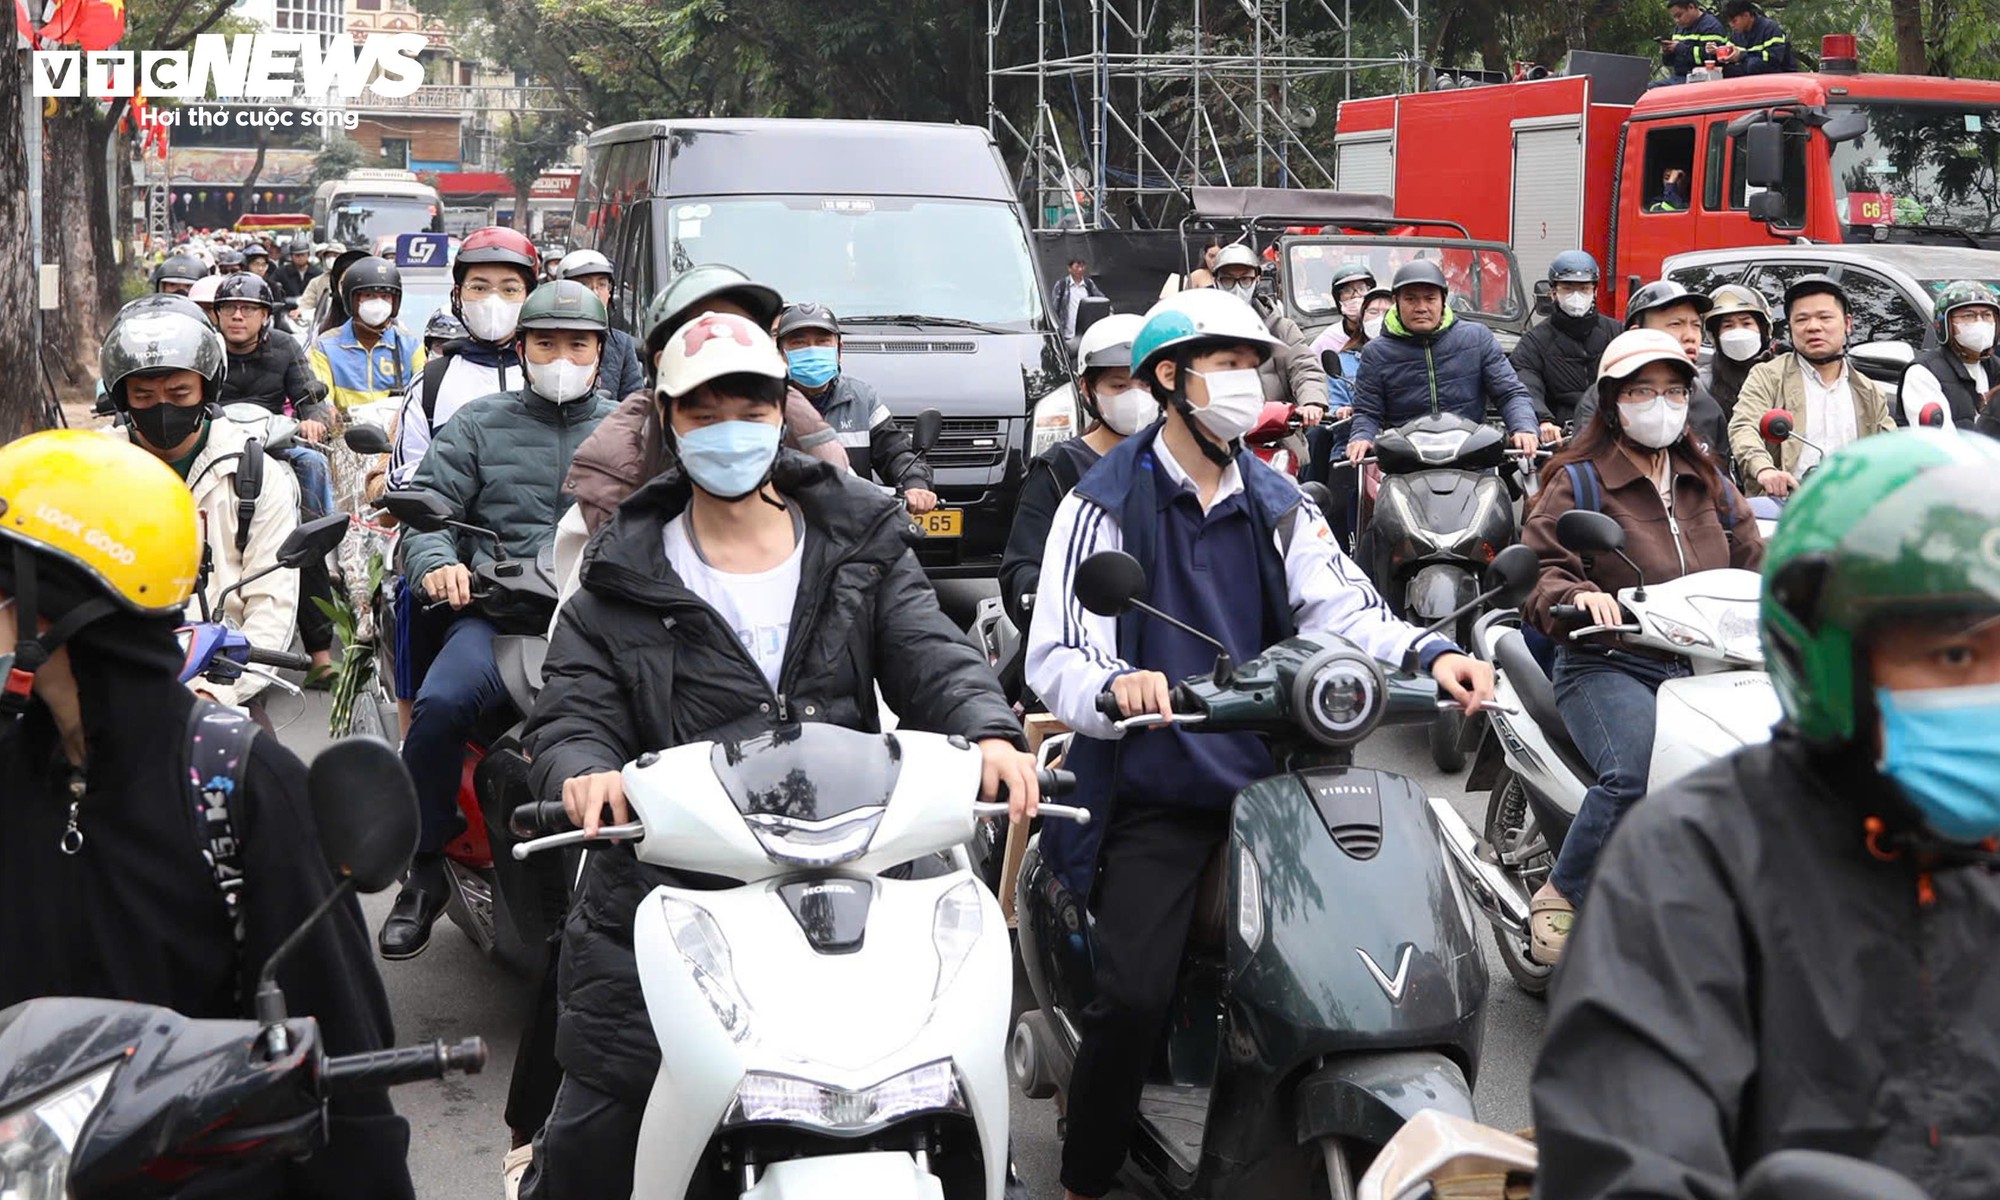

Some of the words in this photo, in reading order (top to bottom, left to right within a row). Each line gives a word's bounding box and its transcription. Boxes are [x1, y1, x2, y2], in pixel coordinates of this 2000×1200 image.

[1862, 202, 1881, 218] C6
[1540, 221, 1547, 240] 3
[36, 503, 84, 537] LOOK
[84, 529, 137, 565] GOOD
[802, 884, 857, 897] HONDA
